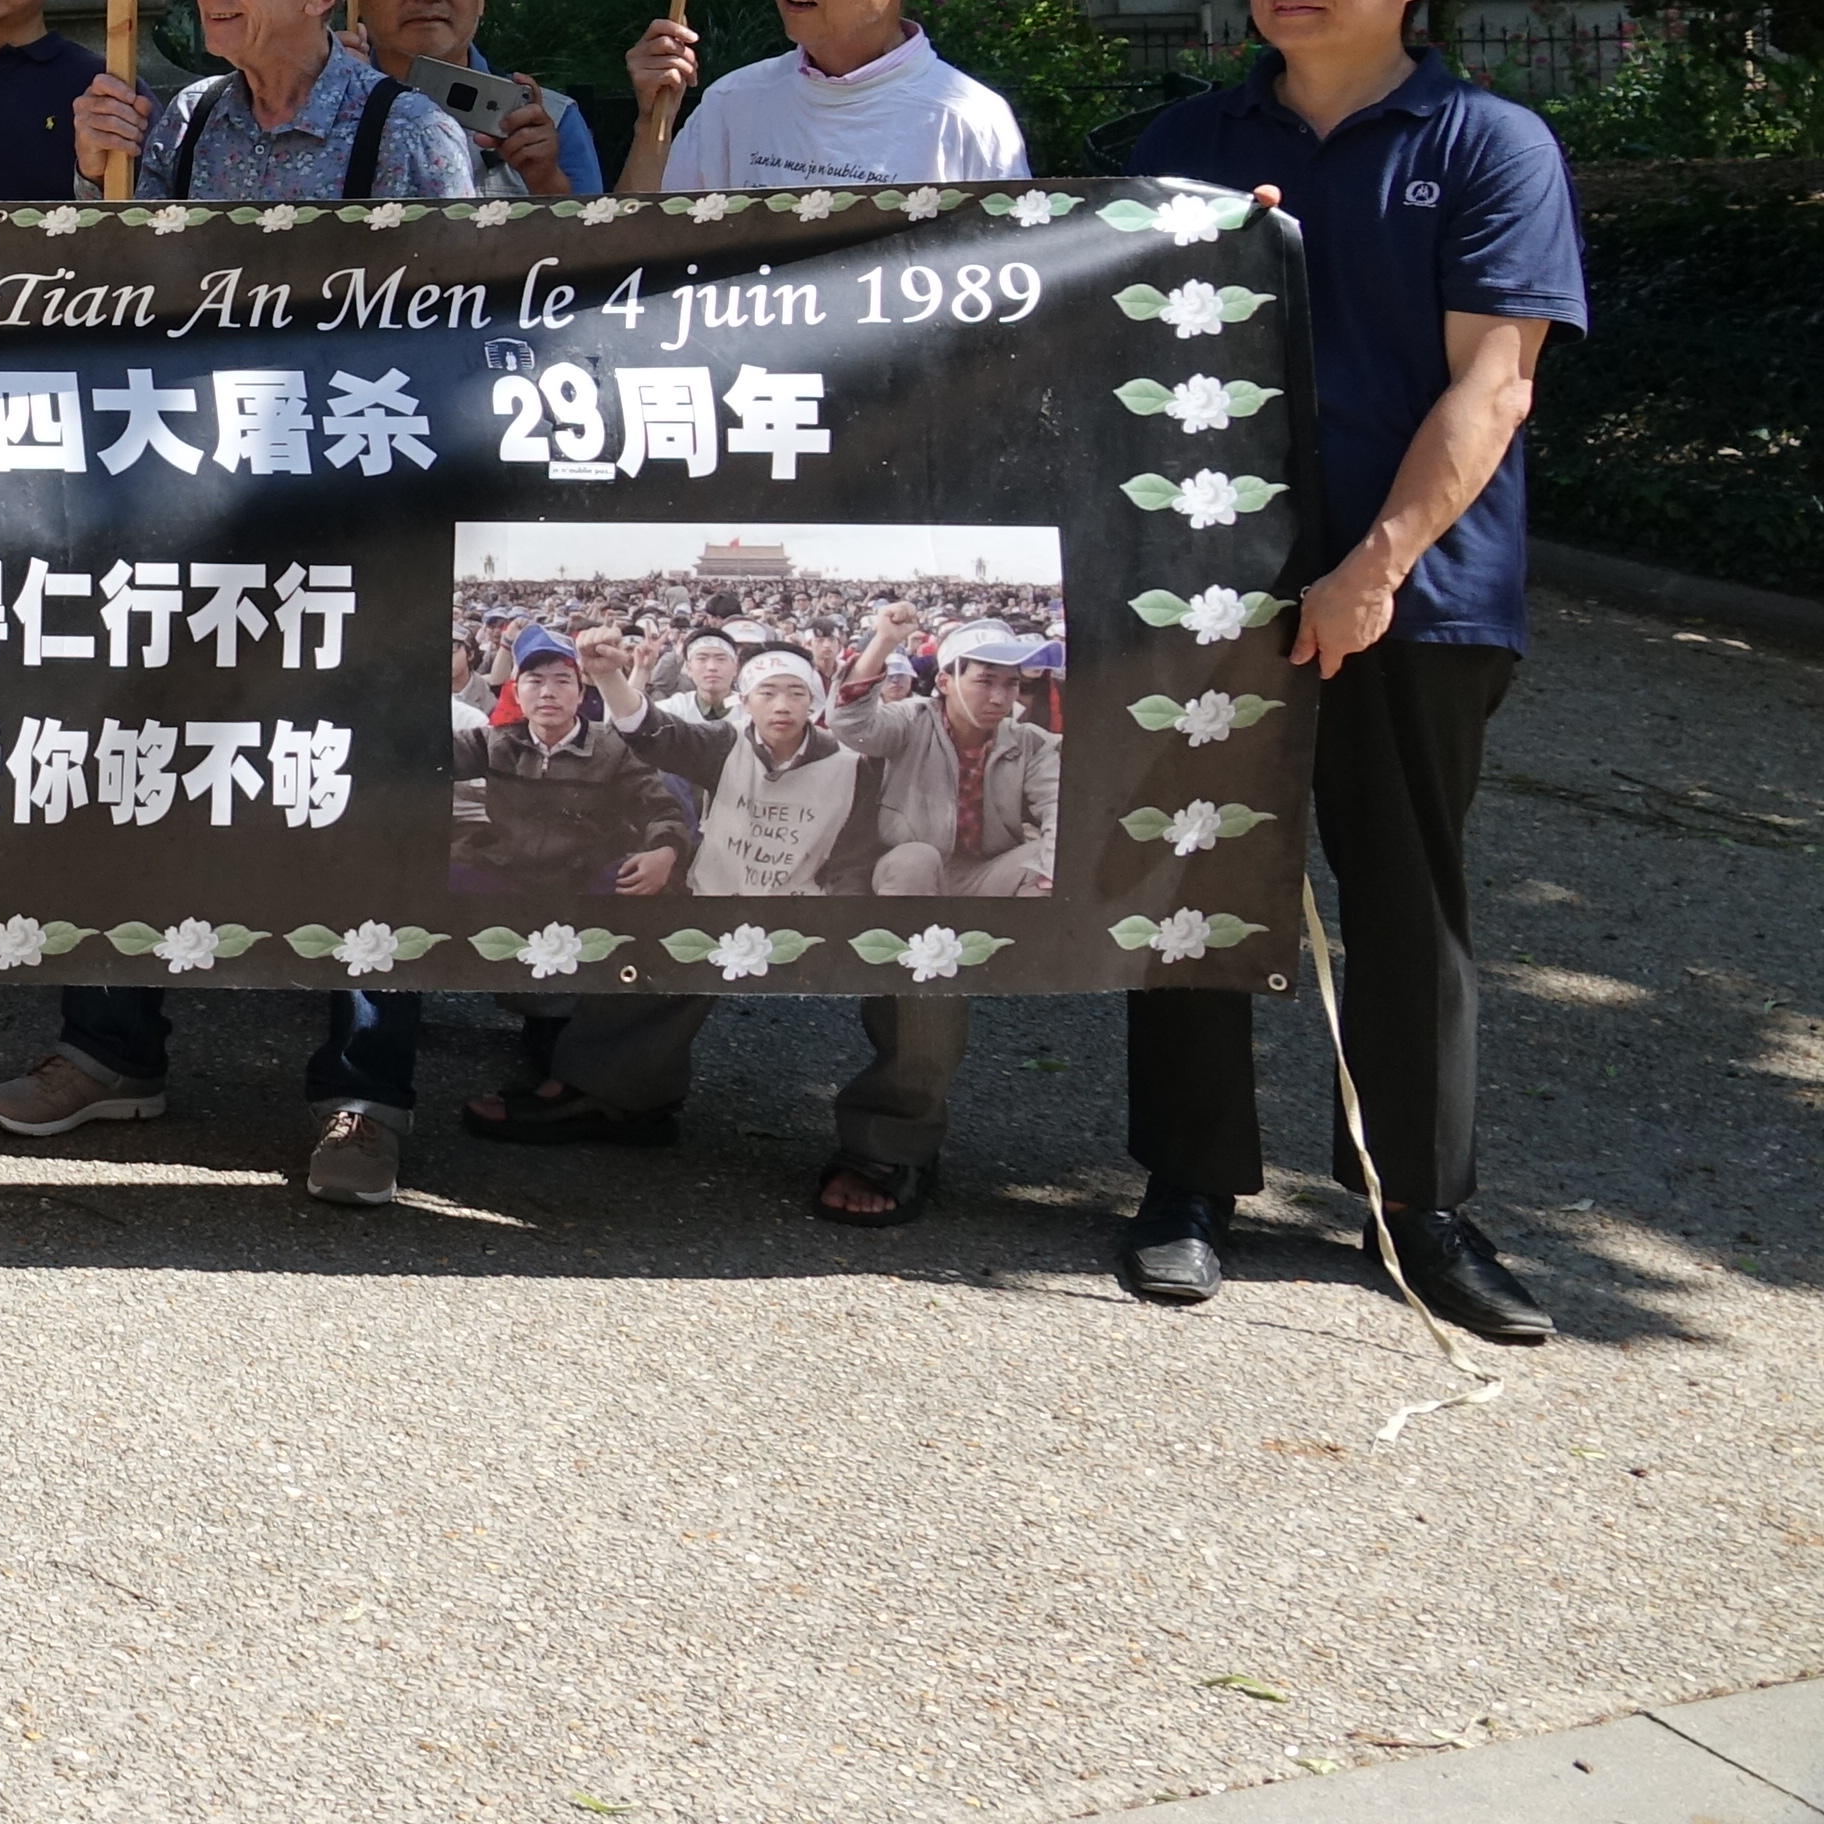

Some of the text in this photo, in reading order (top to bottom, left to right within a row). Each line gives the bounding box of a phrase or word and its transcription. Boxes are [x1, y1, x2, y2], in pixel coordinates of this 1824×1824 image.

[166, 266, 293, 338] An
[317, 265, 492, 333] Men
[518, 257, 576, 330] le
[601, 267, 645, 330] 4
[660, 263, 827, 351] juin
[857, 261, 1043, 326] 1989
[492, 361, 832, 480] 29周年
[753, 804, 789, 822] LIFE
[799, 808, 815, 823] IS
[727, 836, 752, 860] MY
[745, 865, 789, 887] YOUR
